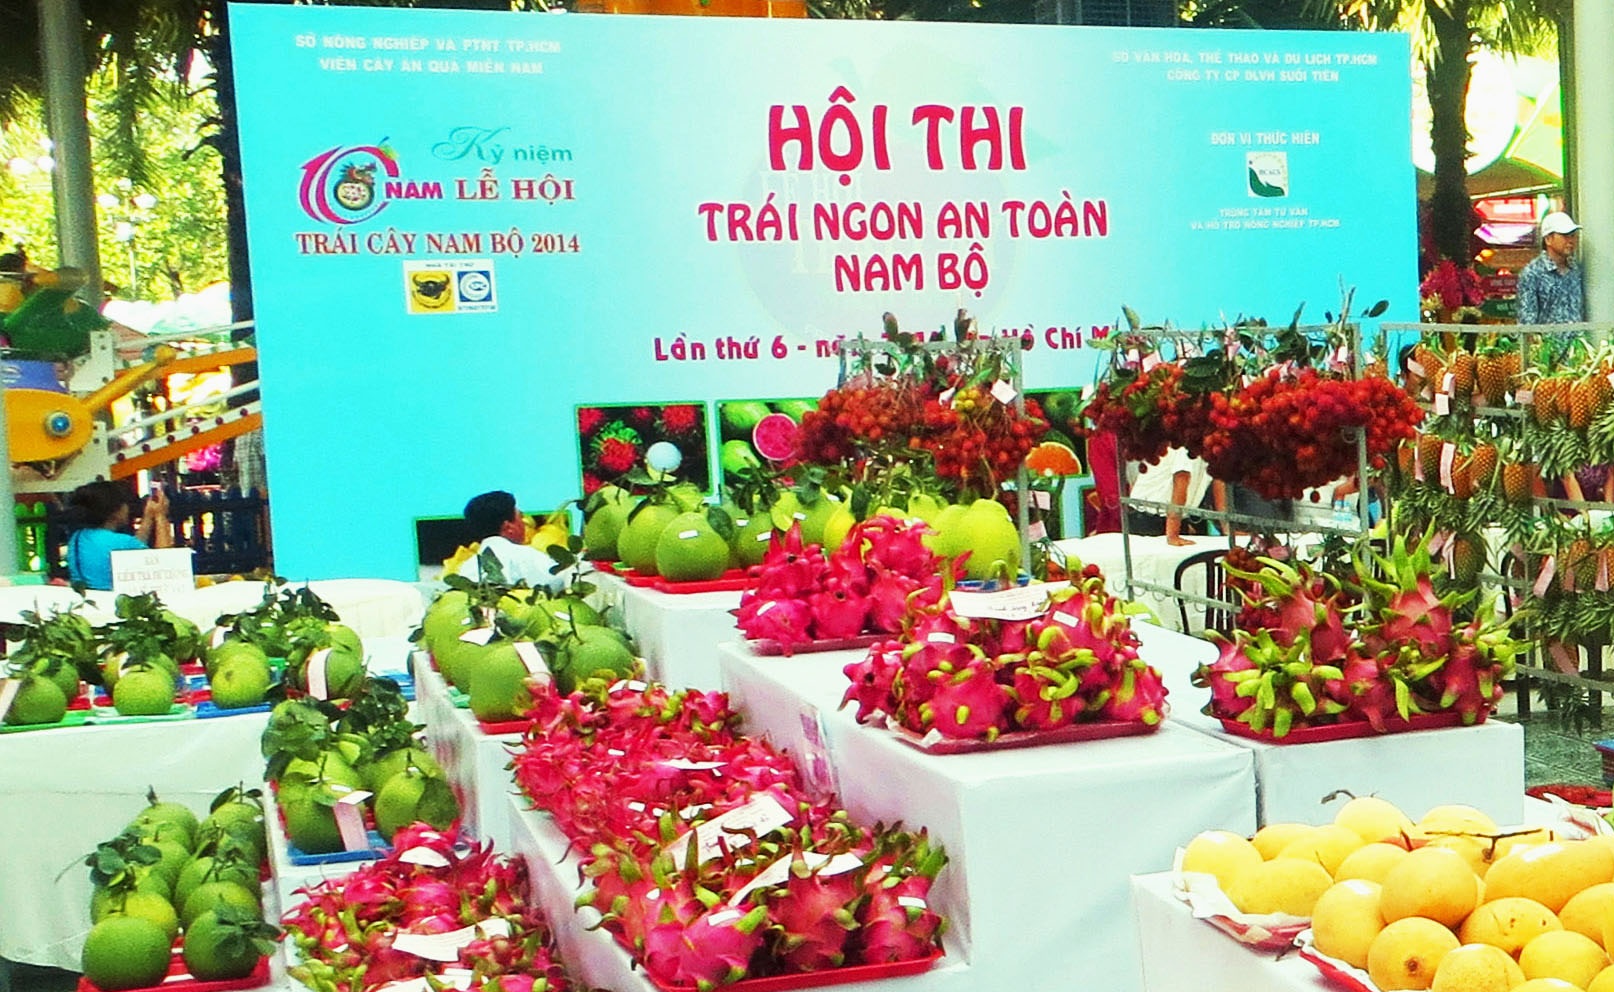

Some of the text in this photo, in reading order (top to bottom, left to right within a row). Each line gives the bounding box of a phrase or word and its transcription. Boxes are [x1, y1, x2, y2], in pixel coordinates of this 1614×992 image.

[513, 144, 573, 165] niệm
[768, 85, 1028, 186] HỘI THI
[455, 168, 500, 201] LỄ
[511, 173, 577, 206] HỘI
[698, 190, 1109, 241] TRÁI NGON AN TOÀN
[296, 226, 581, 259] TRÁI CÂY NAM BỘ 2014
[834, 242, 989, 299] NAM BỘ
[654, 331, 705, 361] Lần
[715, 335, 760, 360] thứ
[771, 335, 788, 359] 6
[1045, 325, 1082, 349] Chí
